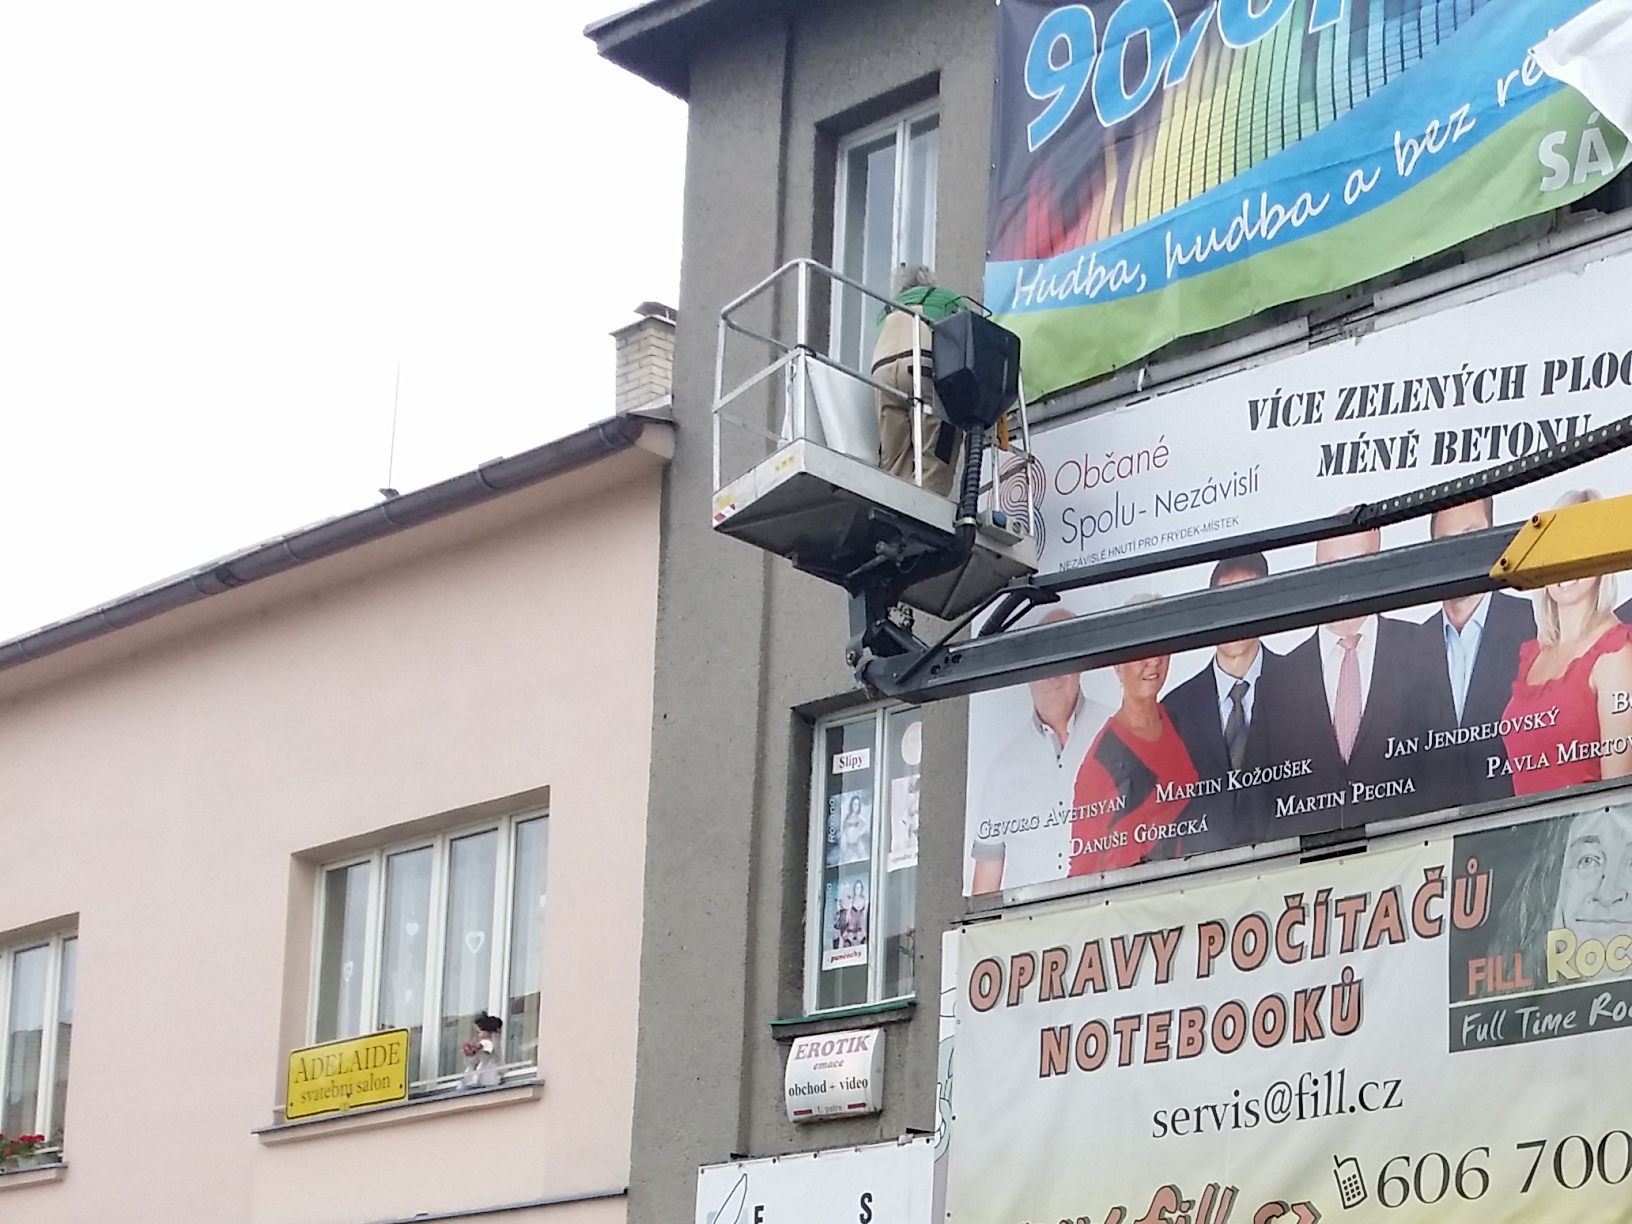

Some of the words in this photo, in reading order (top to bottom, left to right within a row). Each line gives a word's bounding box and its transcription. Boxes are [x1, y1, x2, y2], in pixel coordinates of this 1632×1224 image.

[1010, 250, 1148, 312] Hudba,
[1164, 191, 1330, 280] hudba
[1343, 166, 1381, 206] a
[1393, 102, 1477, 178] bez
[1247, 387, 1327, 431] VÍCE
[1334, 363, 1529, 422] ZELENÝCH
[1053, 434, 1170, 496] Občané
[1154, 464, 1260, 518] Nezávislí
[1138, 533, 1160, 550] PRO
[1384, 736, 1419, 760] JAN
[1423, 705, 1561, 750] JENDREJOVSKÝ
[838, 754, 864, 770] Slipy
[1154, 777, 1223, 804] MARTIN
[1225, 757, 1313, 792] KOŽOUŠEK
[1486, 755, 1551, 780] PAVLA
[977, 813, 1040, 840] GEVORG
[1043, 795, 1127, 828] AVETISYAN
[1275, 791, 1347, 819] MARTIN
[1351, 777, 1417, 804] PECINA
[1069, 829, 1129, 858] DANUŠE
[1133, 815, 1209, 844] GÓRECKÁ
[968, 925, 1186, 1013] OPRAVY
[1196, 856, 1494, 980] POČÍTAČŮ
[1467, 951, 1533, 996] FILL
[1038, 965, 1365, 1079] NOTEBOOKŮ
[1461, 1008, 1505, 1047] Full
[1515, 1005, 1577, 1039] Time
[293, 1041, 402, 1084] ADELAIDE
[794, 1034, 871, 1061] EROTIK
[812, 1059, 844, 1071] emace
[356, 1072, 391, 1094] salon
[788, 1079, 827, 1097] obchod
[839, 1075, 869, 1091] video
[1151, 1068, 1404, 1139] servis@fill.cz
[1375, 1145, 1491, 1209] 606
[858, 1192, 873, 1224] S
